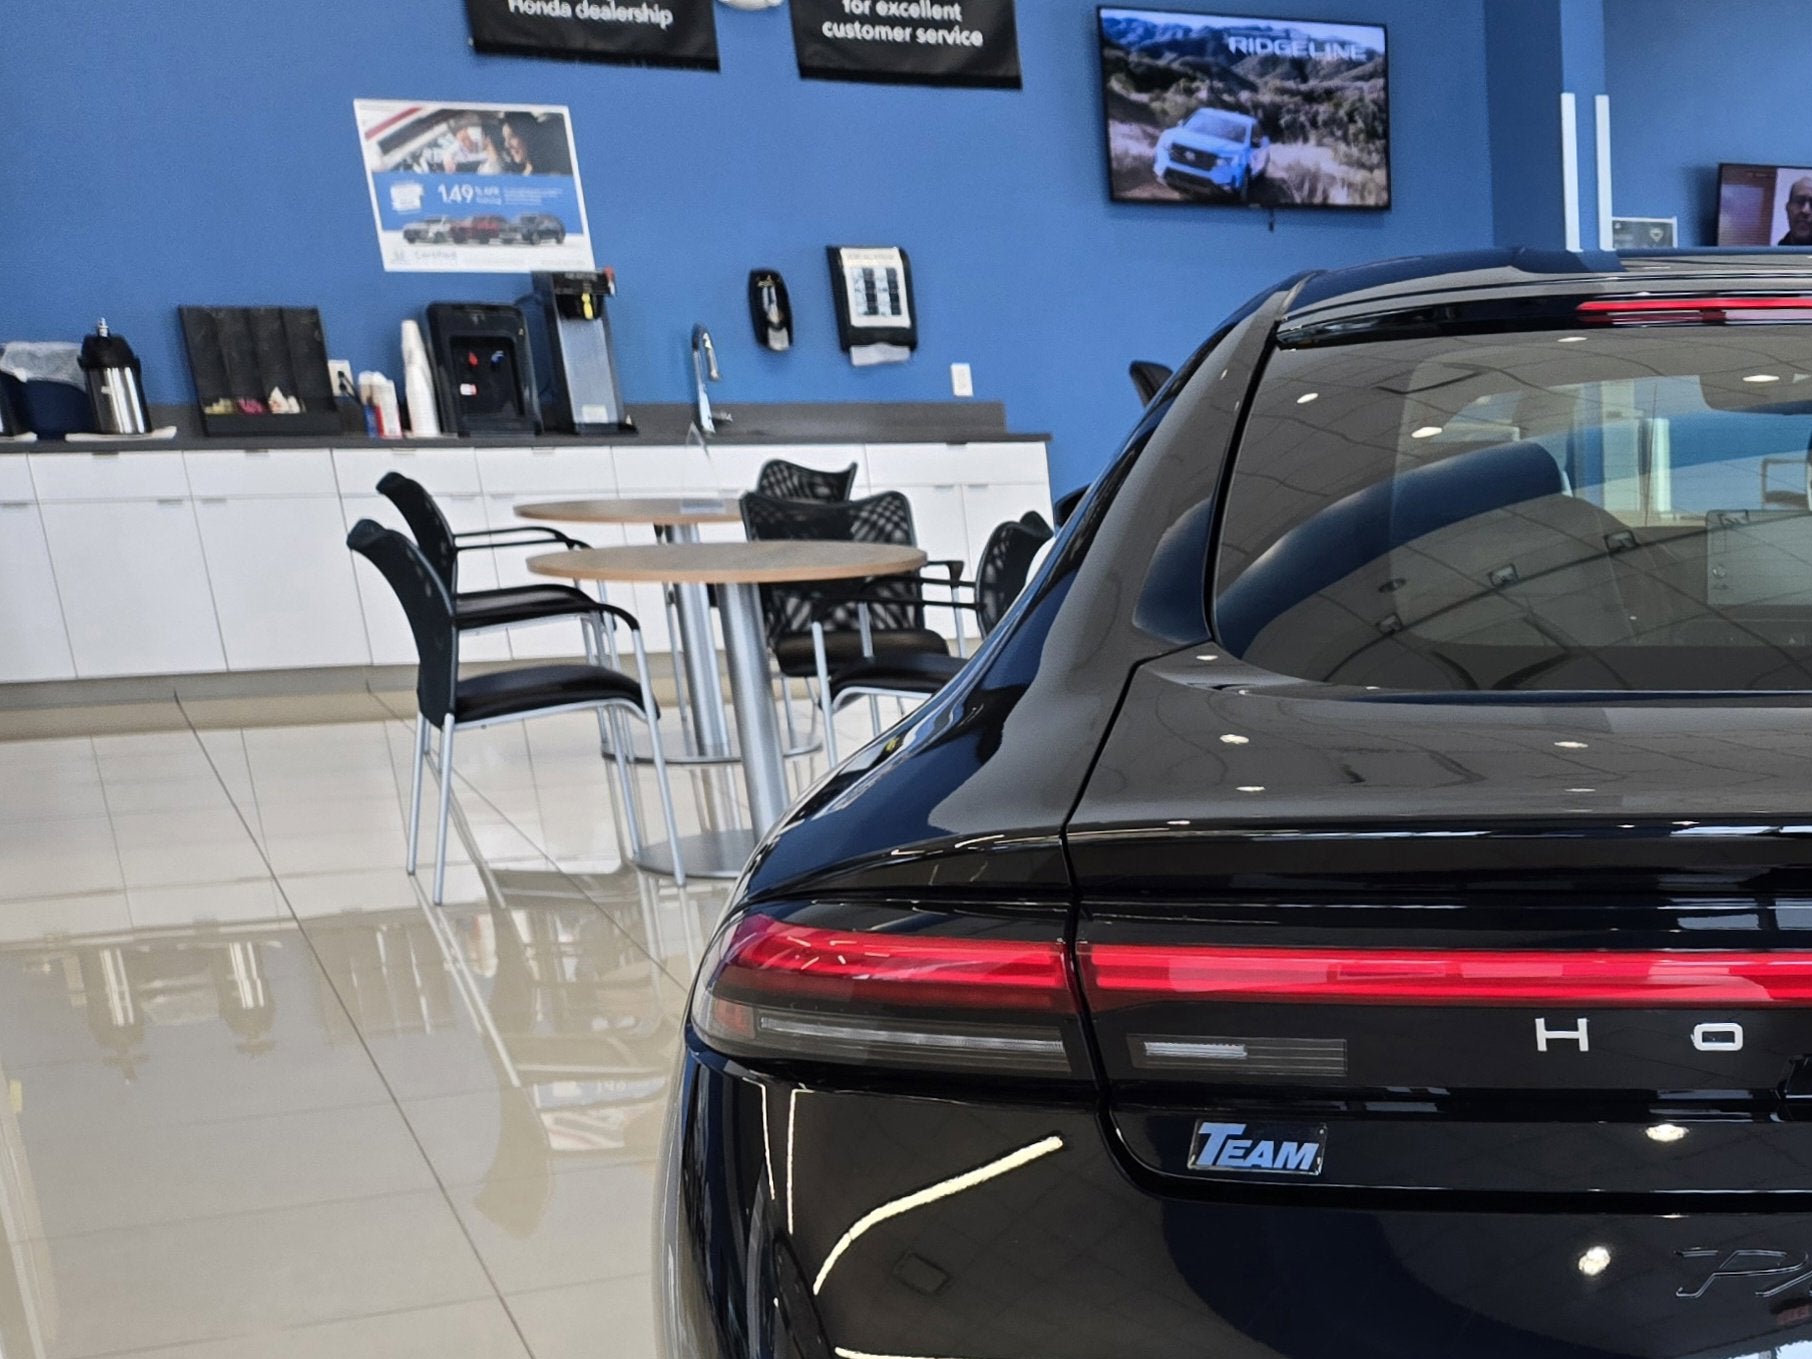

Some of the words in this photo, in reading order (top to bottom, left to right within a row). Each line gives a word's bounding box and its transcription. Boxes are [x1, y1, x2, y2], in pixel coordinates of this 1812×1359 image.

[508, 0, 572, 18] Honda
[575, 0, 674, 30] dealership
[842, 0, 871, 15] for
[875, 0, 962, 22] excellent
[822, 20, 912, 42] customer
[915, 25, 983, 47] service
[1228, 35, 1368, 62] RIDGELINE
